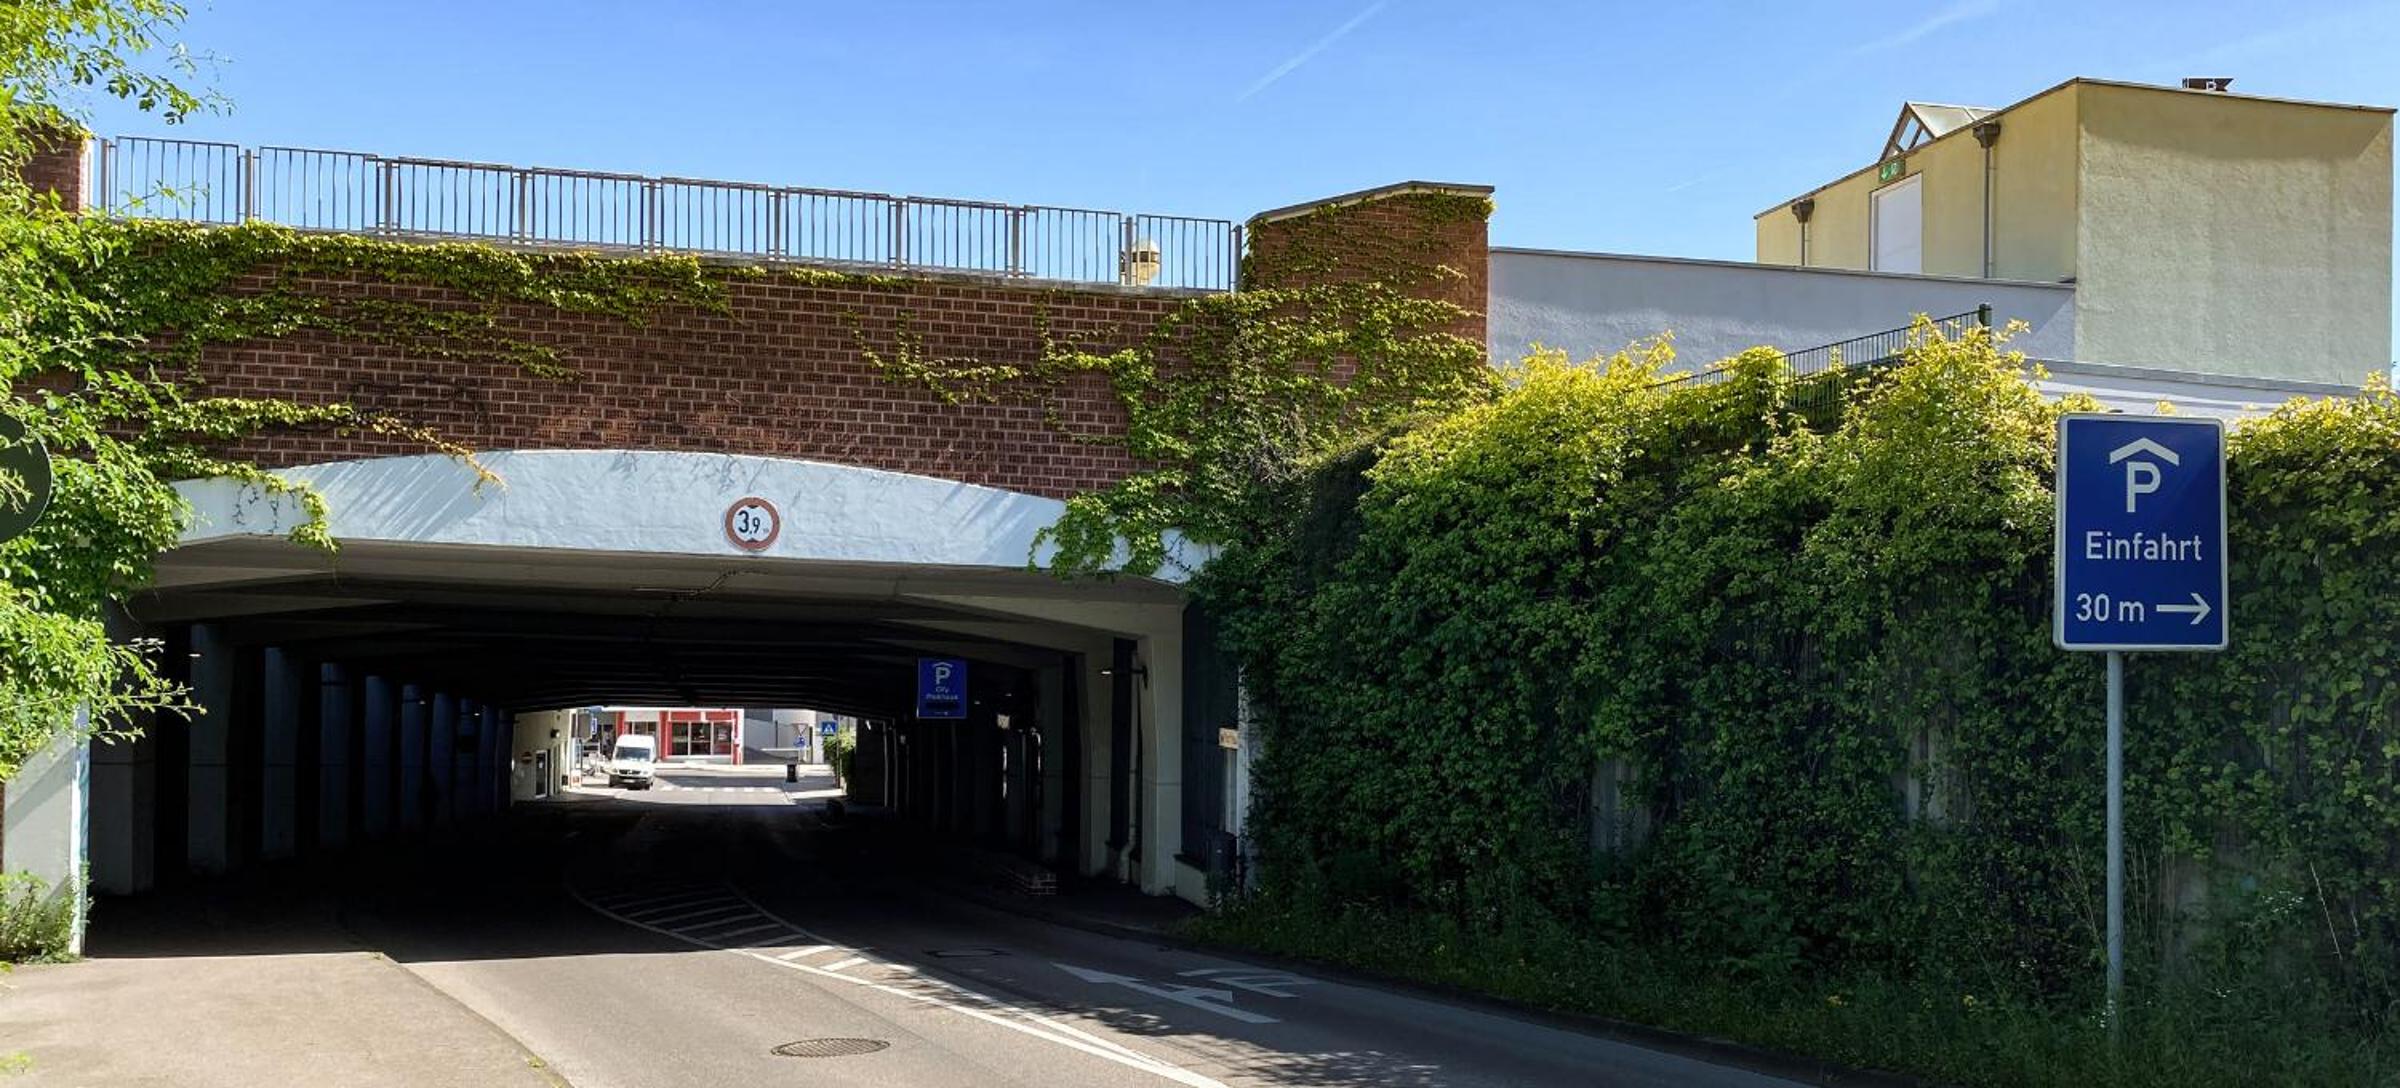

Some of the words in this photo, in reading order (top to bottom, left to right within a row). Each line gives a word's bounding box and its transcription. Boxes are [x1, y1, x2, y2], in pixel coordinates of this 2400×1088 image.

[2126, 461, 2161, 512] P
[2086, 531, 2202, 561] Einfahrt
[2076, 593, 2109, 621] 30
[2118, 601, 2145, 622] m
[935, 666, 951, 685] P
